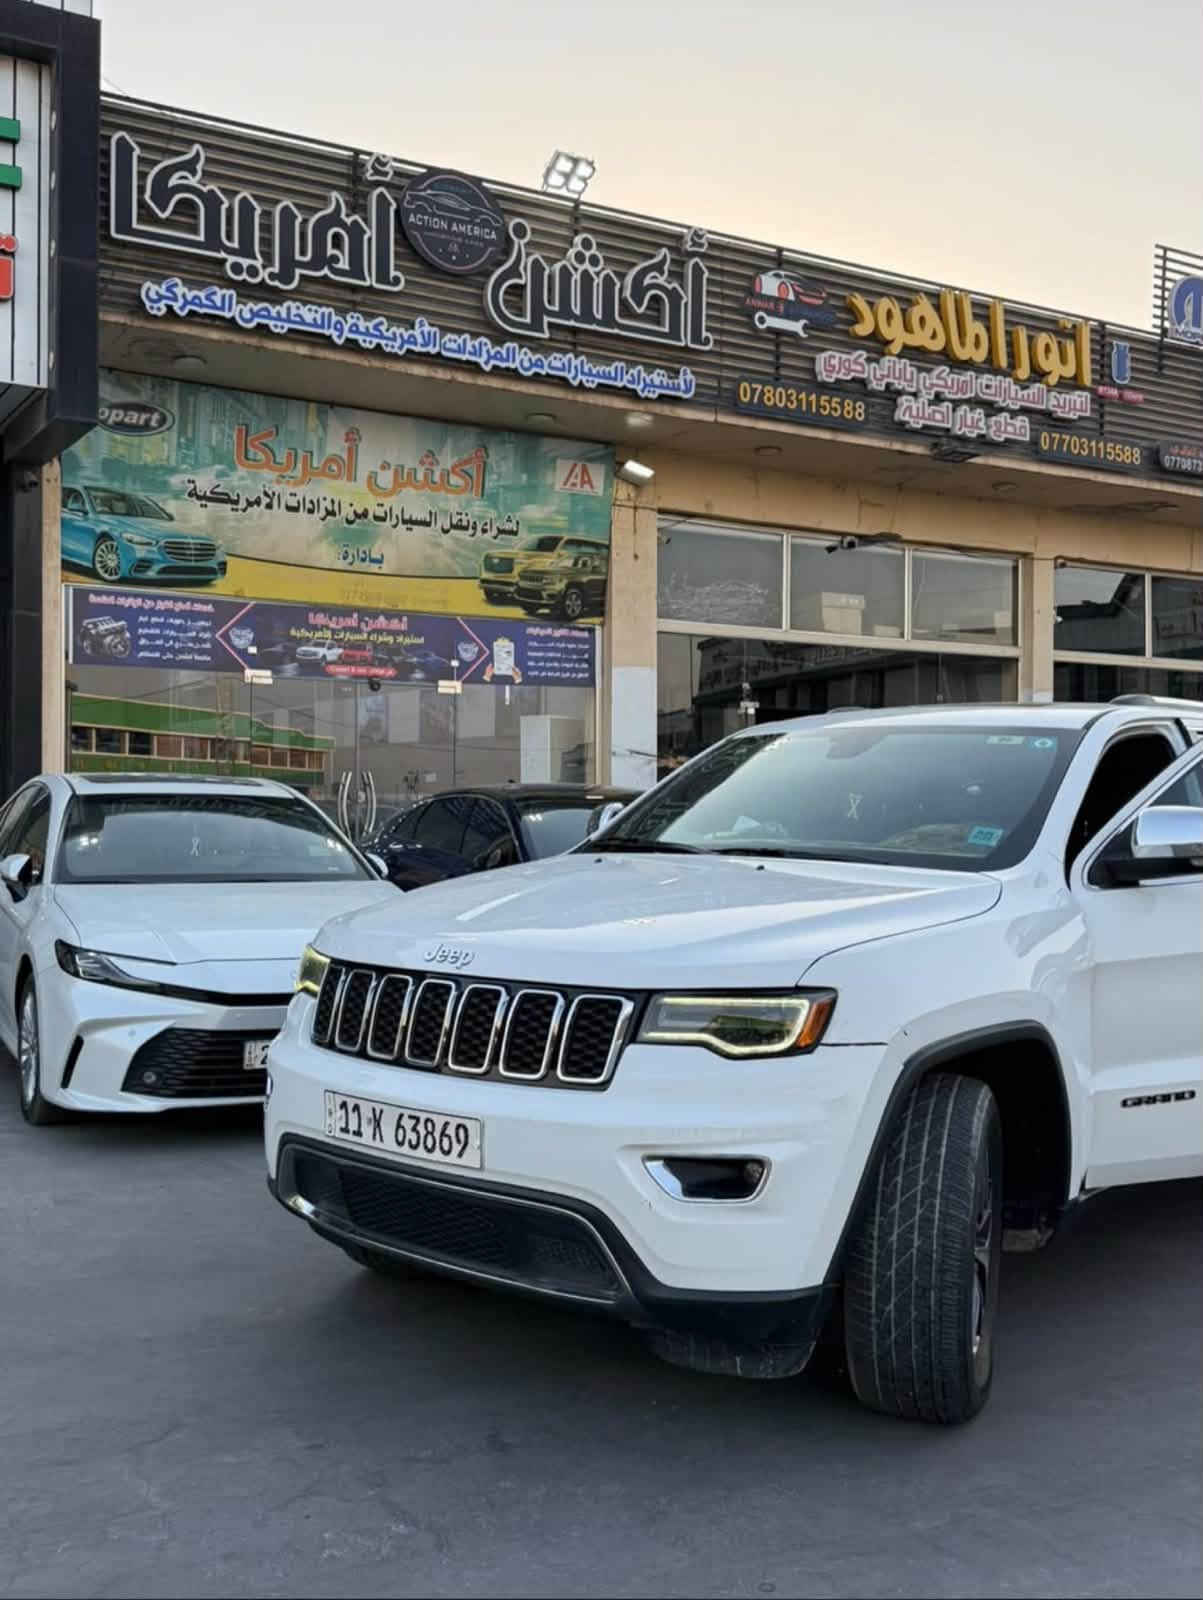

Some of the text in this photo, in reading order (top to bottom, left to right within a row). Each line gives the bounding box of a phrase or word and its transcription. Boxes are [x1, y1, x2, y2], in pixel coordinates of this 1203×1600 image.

[110, 130, 405, 291] أمريكا
[408, 213, 448, 231] ACTION
[451, 223, 497, 241] AMERICA
[487, 218, 713, 350] أكشن
[237, 300, 345, 344] والتخليص
[347, 313, 439, 353] الأمريكية
[441, 334, 517, 369] المزادات
[519, 348, 546, 375] من
[547, 353, 625, 387] السيارات
[739, 382, 865, 421] 07803115588
[977, 375, 1047, 409] السيارات
[98, 407, 160, 427] opart
[988, 412, 1029, 441] قطع
[235, 425, 489, 498] أكشن أمريكا
[1040, 431, 1141, 465] 07703115588
[285, 492, 342, 521] المزادات
[345, 502, 369, 525] من
[373, 503, 438, 532] السيارات
[441, 511, 479, 537] ونقل
[481, 514, 520, 540] لشراء
[424, 944, 476, 969] Jeep
[1121, 1089, 1197, 1109] GRAND
[339, 1100, 363, 1138] 11
[371, 1106, 385, 1143] K
[394, 1112, 469, 1159] 63869
